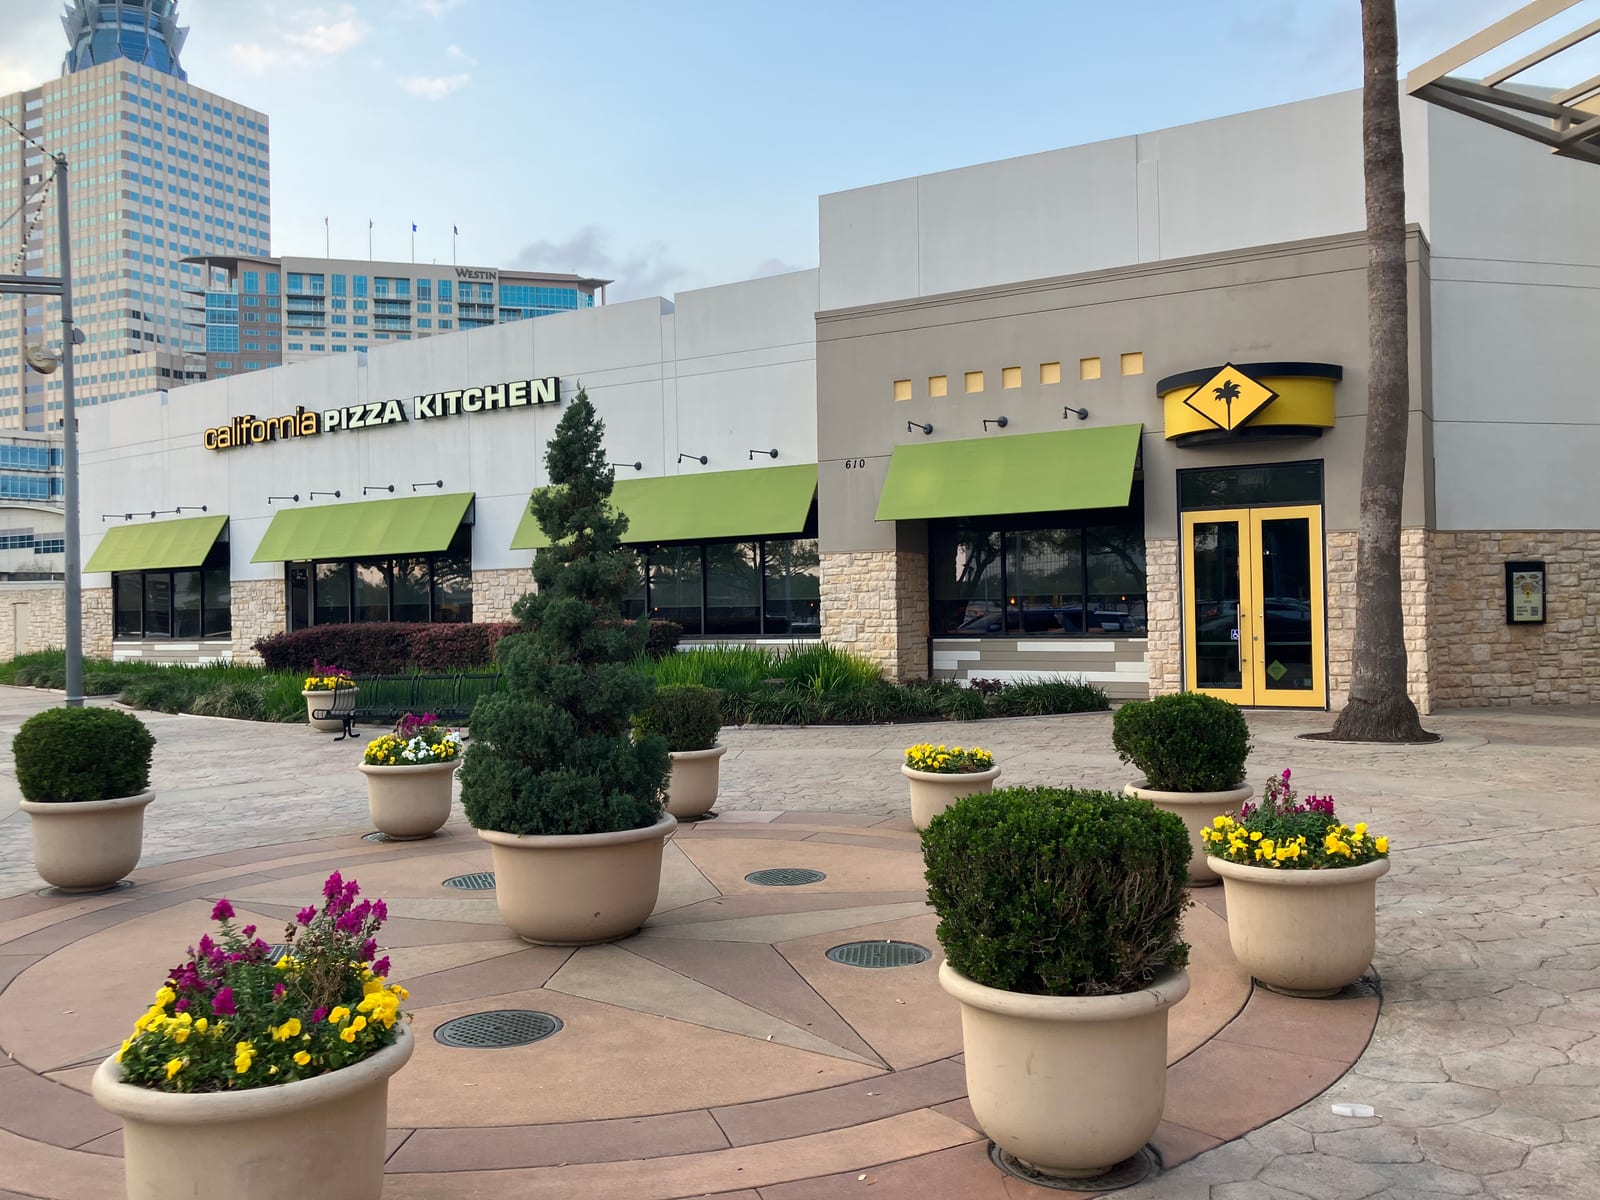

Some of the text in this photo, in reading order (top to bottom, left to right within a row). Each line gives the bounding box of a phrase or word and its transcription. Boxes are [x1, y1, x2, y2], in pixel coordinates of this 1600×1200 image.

[455, 267, 497, 280] WESTIN
[204, 376, 560, 450] california PIZZA KITCHEN
[845, 458, 866, 470] 610
